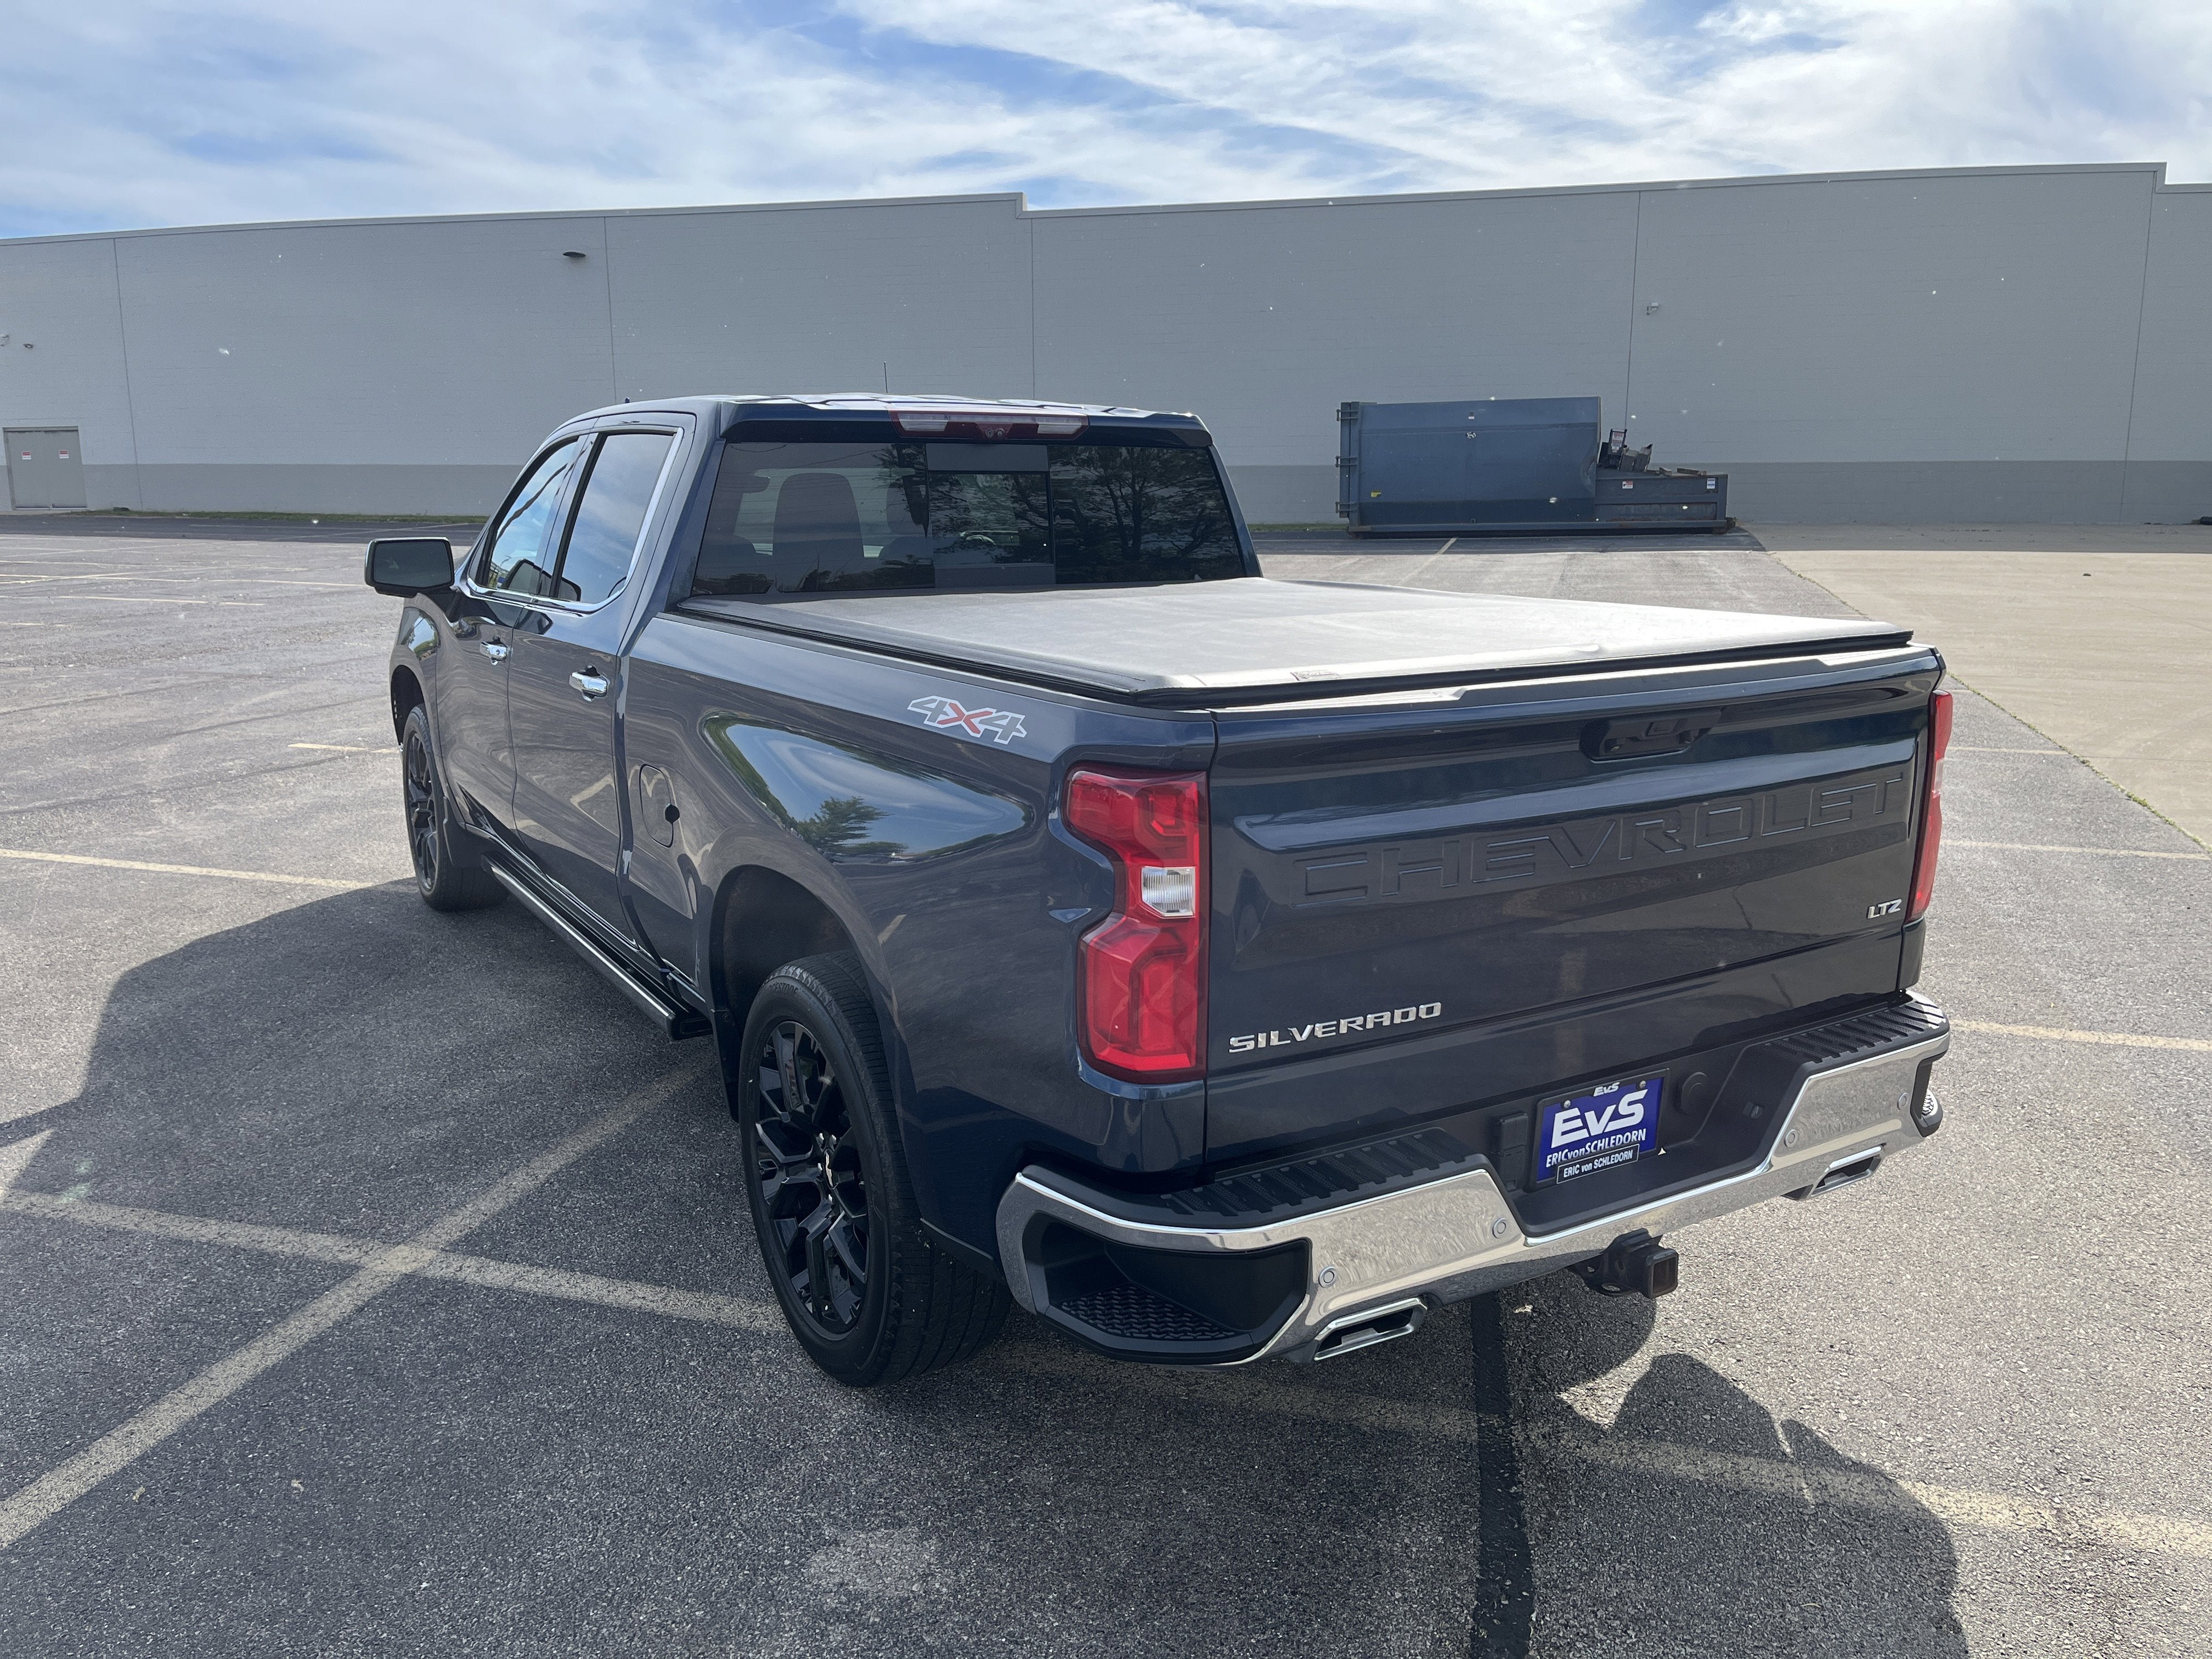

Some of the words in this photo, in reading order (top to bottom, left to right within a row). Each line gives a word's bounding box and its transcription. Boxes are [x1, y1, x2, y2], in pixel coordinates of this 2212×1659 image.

[1289, 774, 1904, 908] CHEVROLET
[1867, 899, 1902, 919] LTZ
[1229, 1001, 1442, 1053] SILVERADO
[1564, 1164, 1580, 1178] ERIC
[1581, 1163, 1593, 1173] von
[1594, 1149, 1633, 1170] SCHLEDORN
